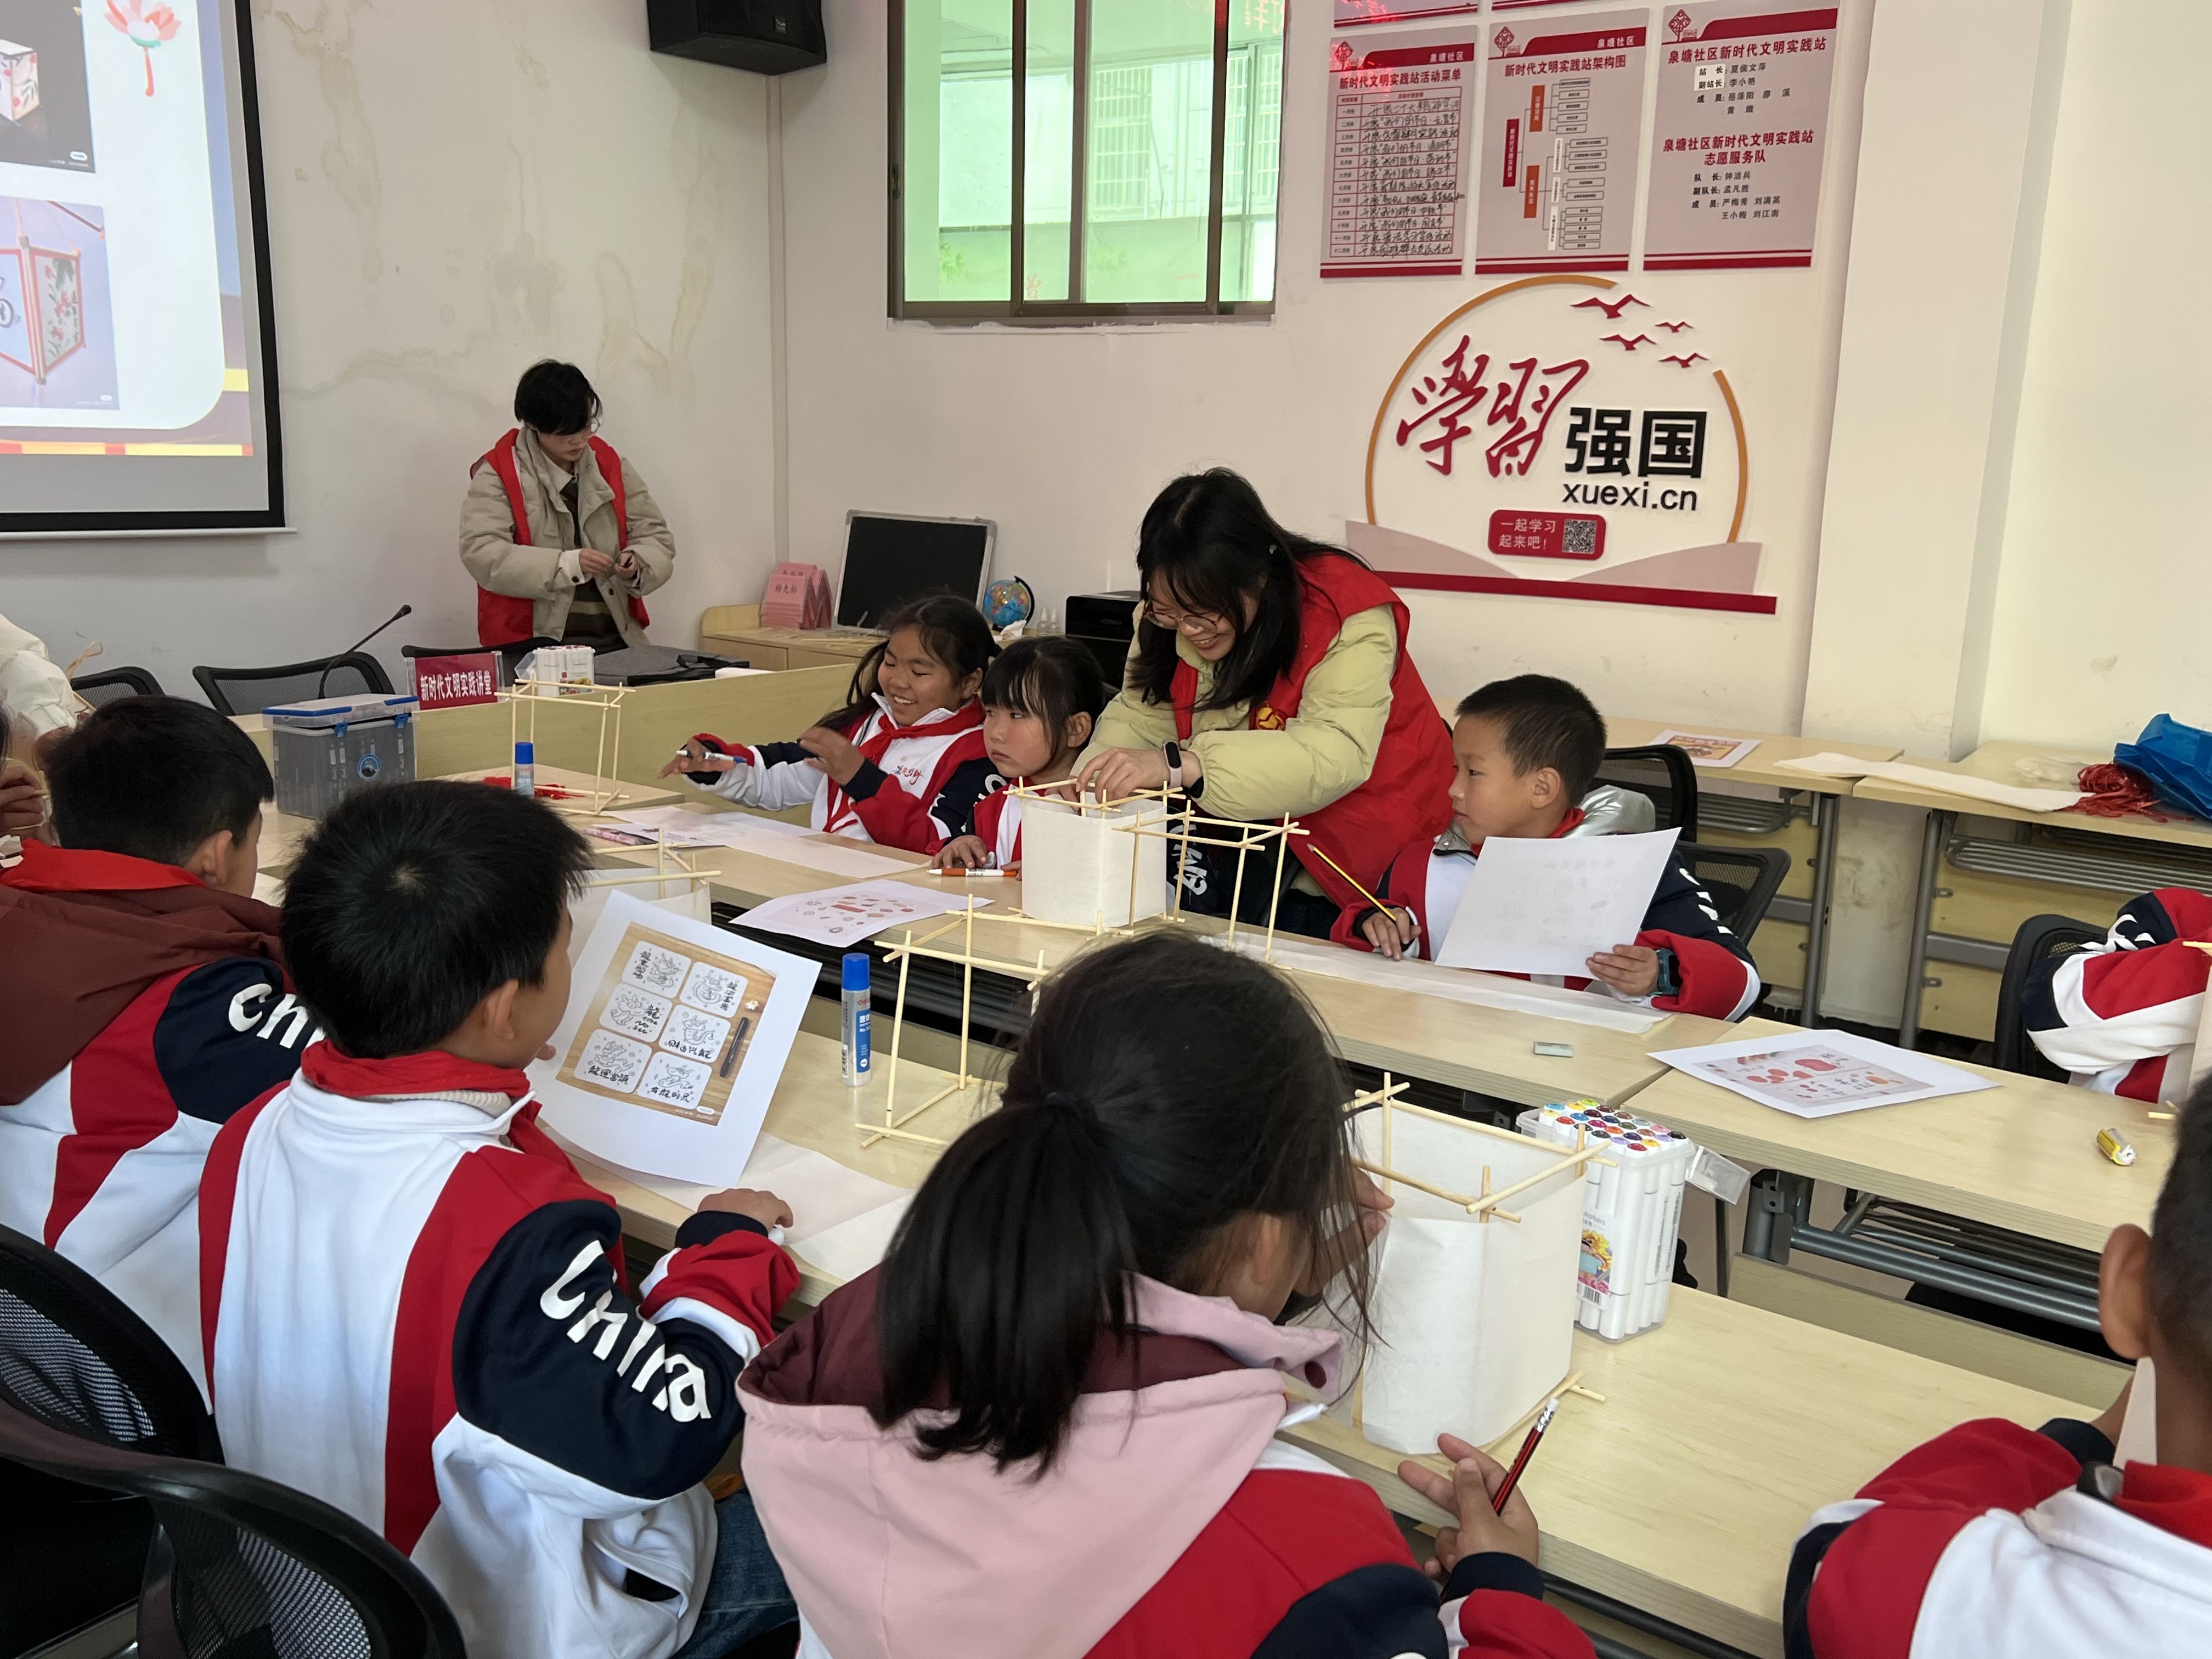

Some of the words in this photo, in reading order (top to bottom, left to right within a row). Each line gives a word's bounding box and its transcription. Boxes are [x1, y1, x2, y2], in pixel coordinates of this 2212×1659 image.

[1597, 36, 1635, 48] 泉塘社区
[1668, 37, 1826, 64] 泉塘社区新时代文明实践站
[1505, 55, 1626, 77] 新时代文明实践站架构图
[1339, 69, 1461, 89] 新时代文明实践站活动菜单
[1663, 129, 1814, 152] 泉塘社区新时代文明实践站
[1705, 149, 1765, 165] 志愿服务队
[1564, 407, 1707, 478] 强国
[1562, 482, 1697, 511] xuexi.cn
[1501, 517, 1556, 533] 一起学习
[420, 670, 492, 702] 新时代文明实践讲堂
